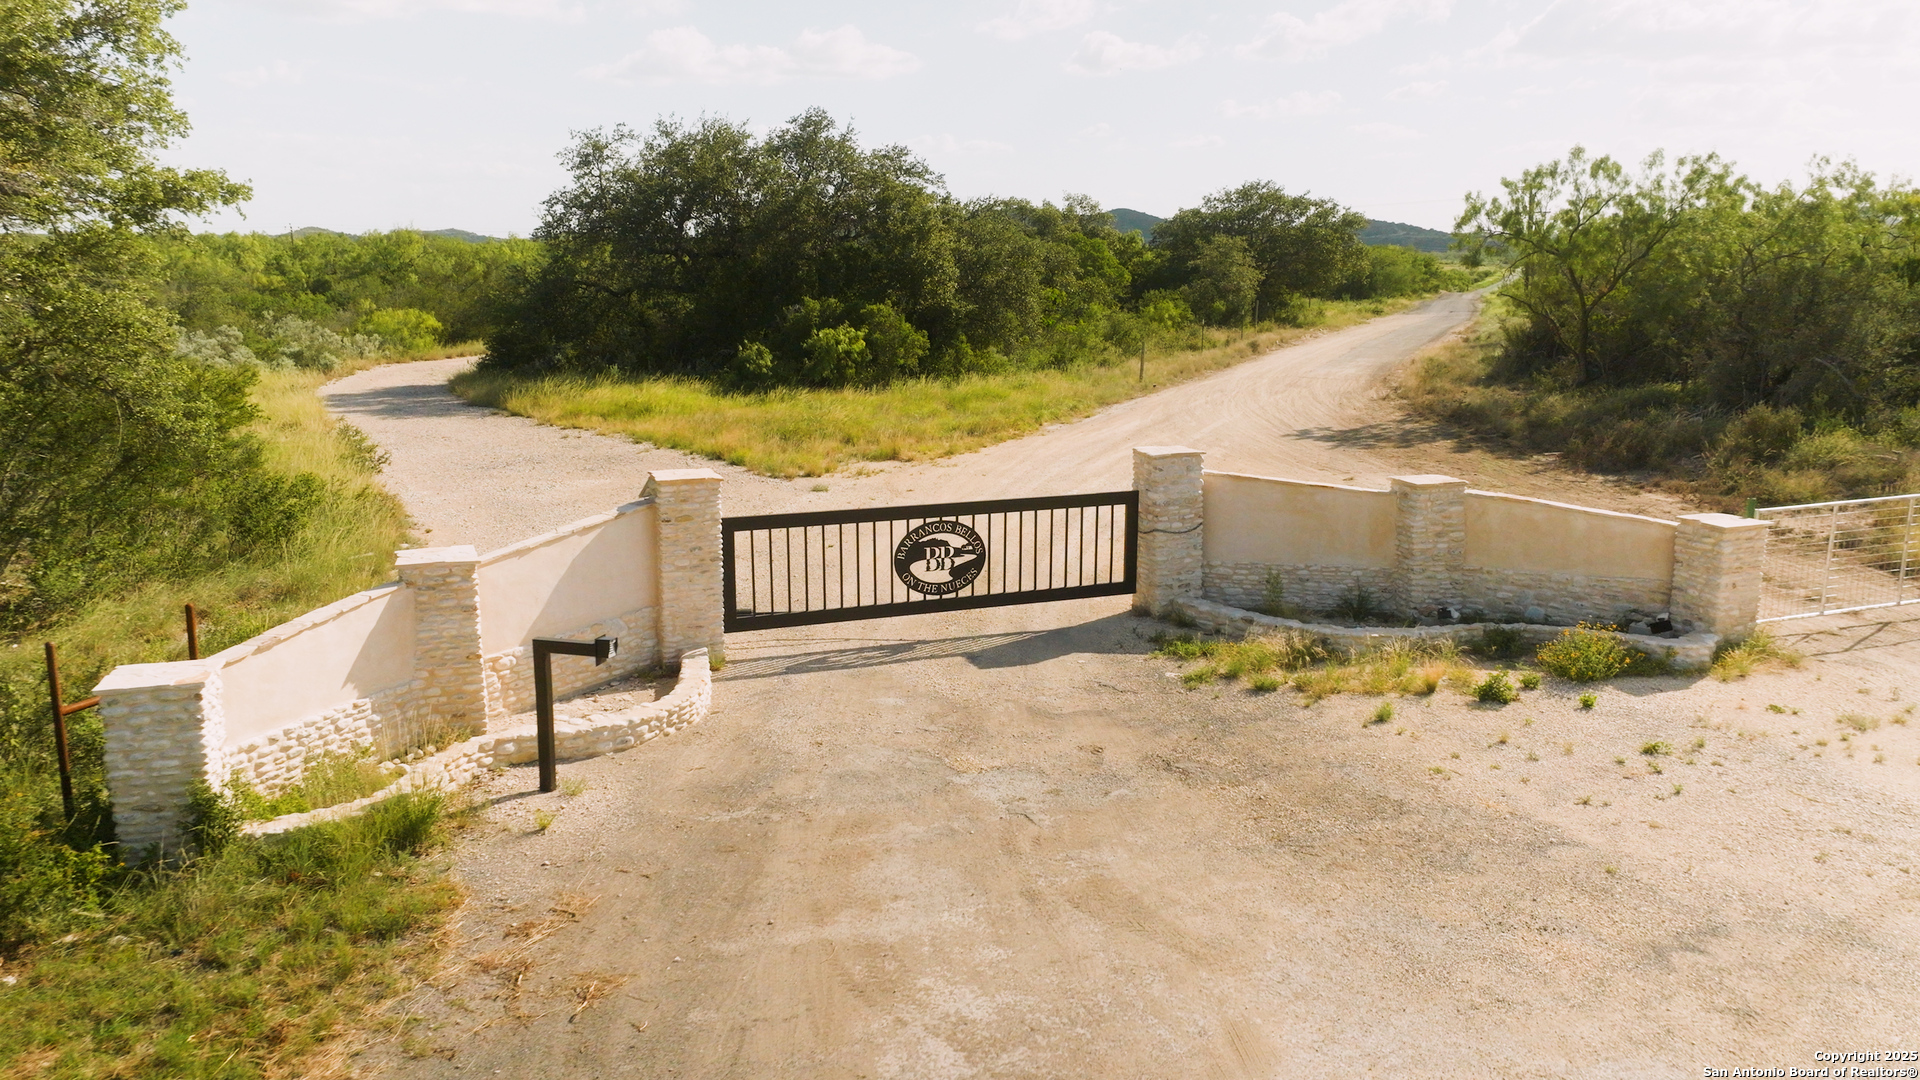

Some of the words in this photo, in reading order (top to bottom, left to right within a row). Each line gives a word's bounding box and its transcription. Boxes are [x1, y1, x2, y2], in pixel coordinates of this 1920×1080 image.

[897, 523, 953, 560] BARRANCOS
[955, 524, 983, 554] BELLOS
[902, 572, 917, 587] ON
[918, 581, 938, 593] THE
[941, 567, 978, 592] NUECES
